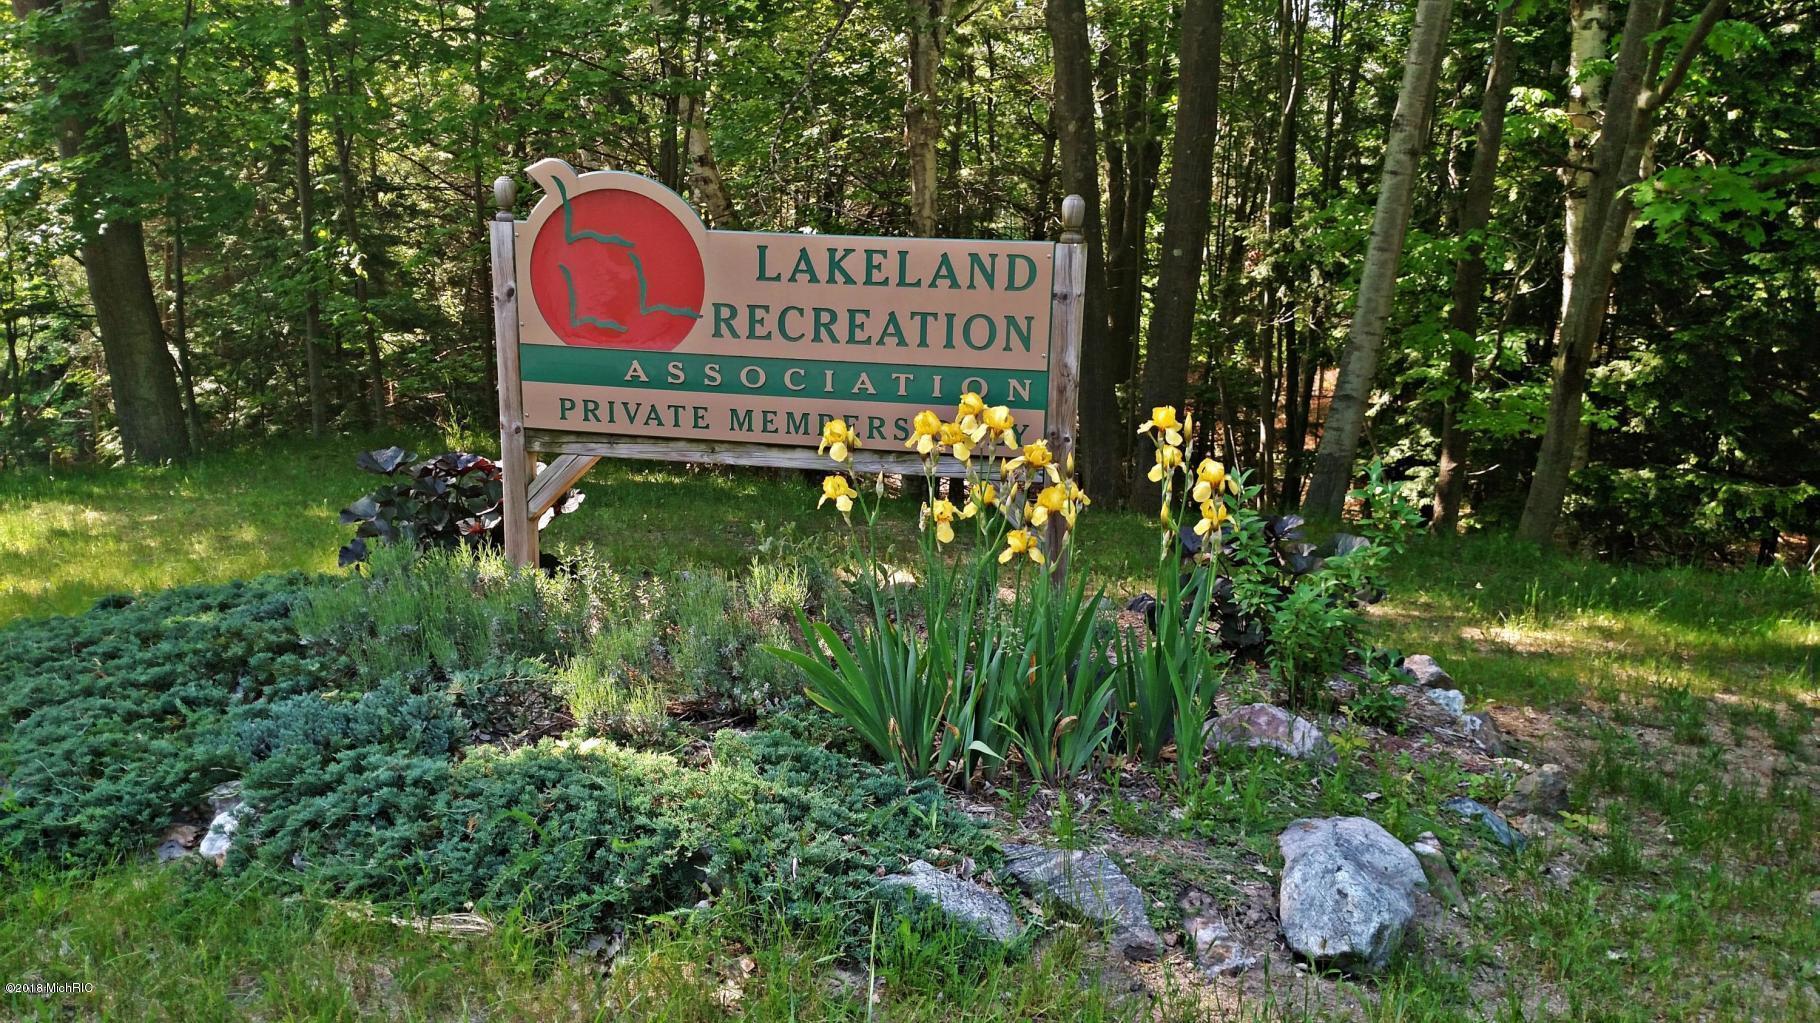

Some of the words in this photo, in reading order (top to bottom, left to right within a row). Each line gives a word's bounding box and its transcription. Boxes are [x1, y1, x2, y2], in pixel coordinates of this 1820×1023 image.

[755, 245, 1038, 291] LAKELAND
[711, 302, 1034, 352] RECREATION
[624, 360, 1032, 402] ASSOCIATION
[559, 397, 710, 429] PRIVATE
